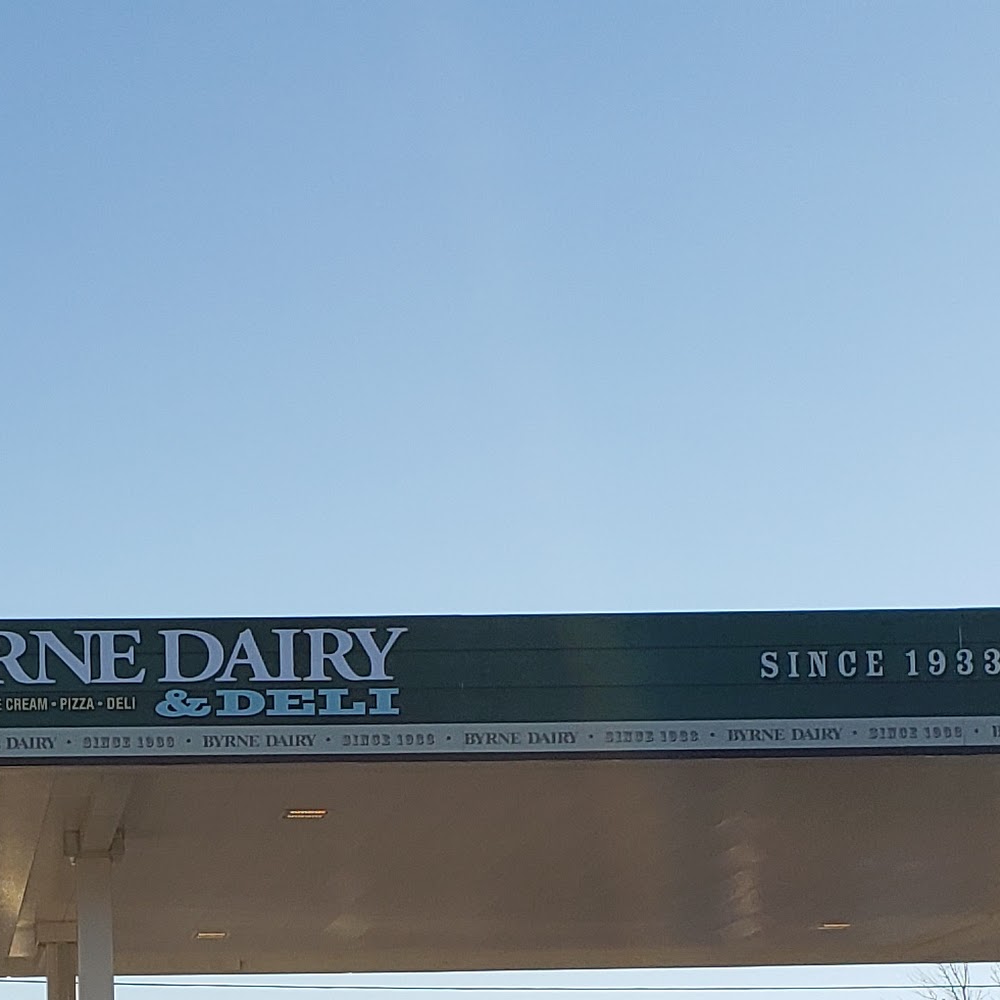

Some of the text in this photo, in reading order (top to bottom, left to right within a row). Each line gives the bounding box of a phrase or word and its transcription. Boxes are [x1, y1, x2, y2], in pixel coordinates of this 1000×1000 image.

[158, 627, 408, 684] DAIRY
[760, 648, 1000, 679] SINCE 1933
[5, 697, 49, 712] CREAM
[59, 697, 95, 712] PIZZA
[106, 696, 136, 711] DELI
[6, 736, 56, 749] DAIRY
[203, 735, 260, 748] BYRNE
[266, 734, 316, 747] DAIRY
[465, 732, 521, 745] BYRNE
[527, 731, 578, 745] DAIRY
[728, 728, 785, 742] BYRNE
[791, 728, 844, 741] DAIRY
